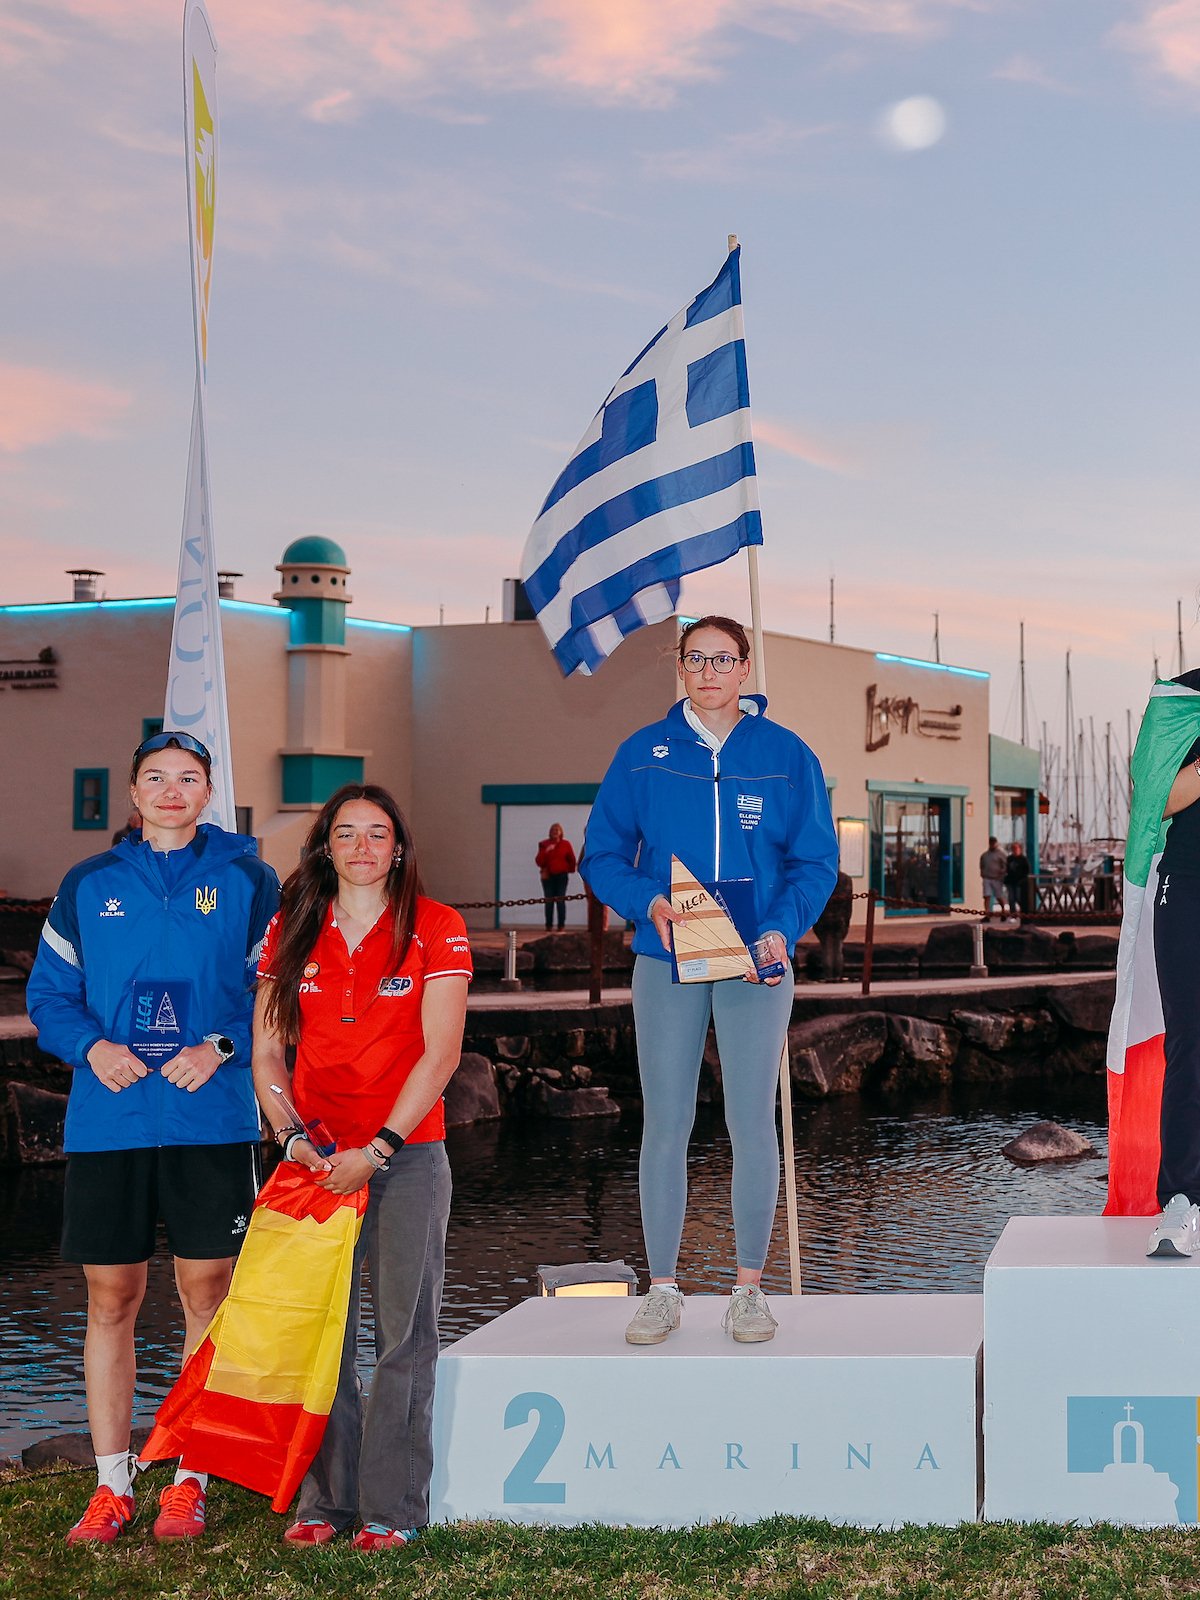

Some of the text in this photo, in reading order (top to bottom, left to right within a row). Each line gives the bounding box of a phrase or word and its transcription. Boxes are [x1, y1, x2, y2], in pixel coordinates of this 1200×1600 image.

[680, 892, 708, 914] ILCA
[1160, 874, 1170, 906] ITA
[135, 995, 154, 1033] ILCA
[503, 1391, 566, 1504] 2
[584, 1442, 941, 1471] MARINA
